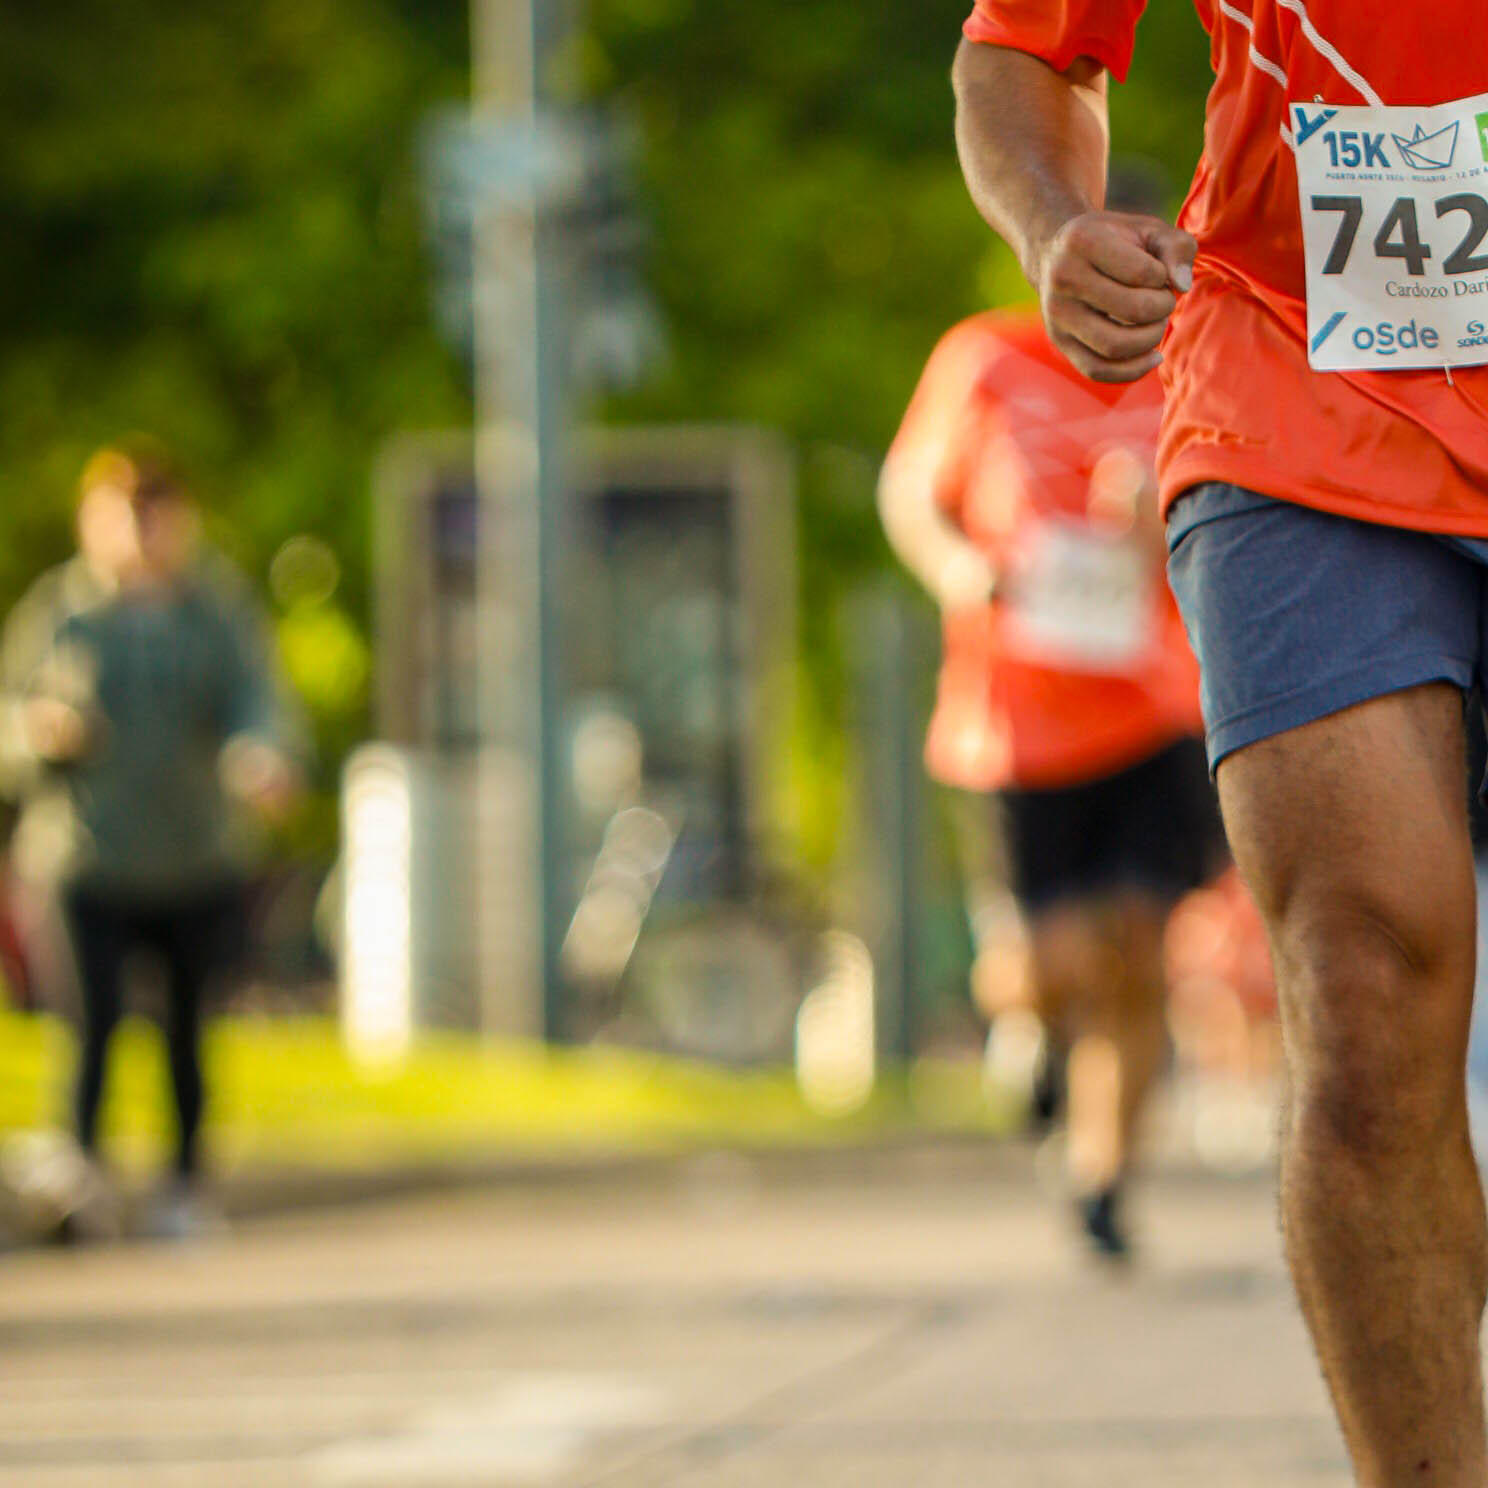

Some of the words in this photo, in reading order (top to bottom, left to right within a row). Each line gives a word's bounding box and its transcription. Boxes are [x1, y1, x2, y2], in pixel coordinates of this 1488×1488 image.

[1322, 130, 1391, 168] 15K
[1385, 280, 1448, 297] Cardozo
[1352, 318, 1439, 354] osde
